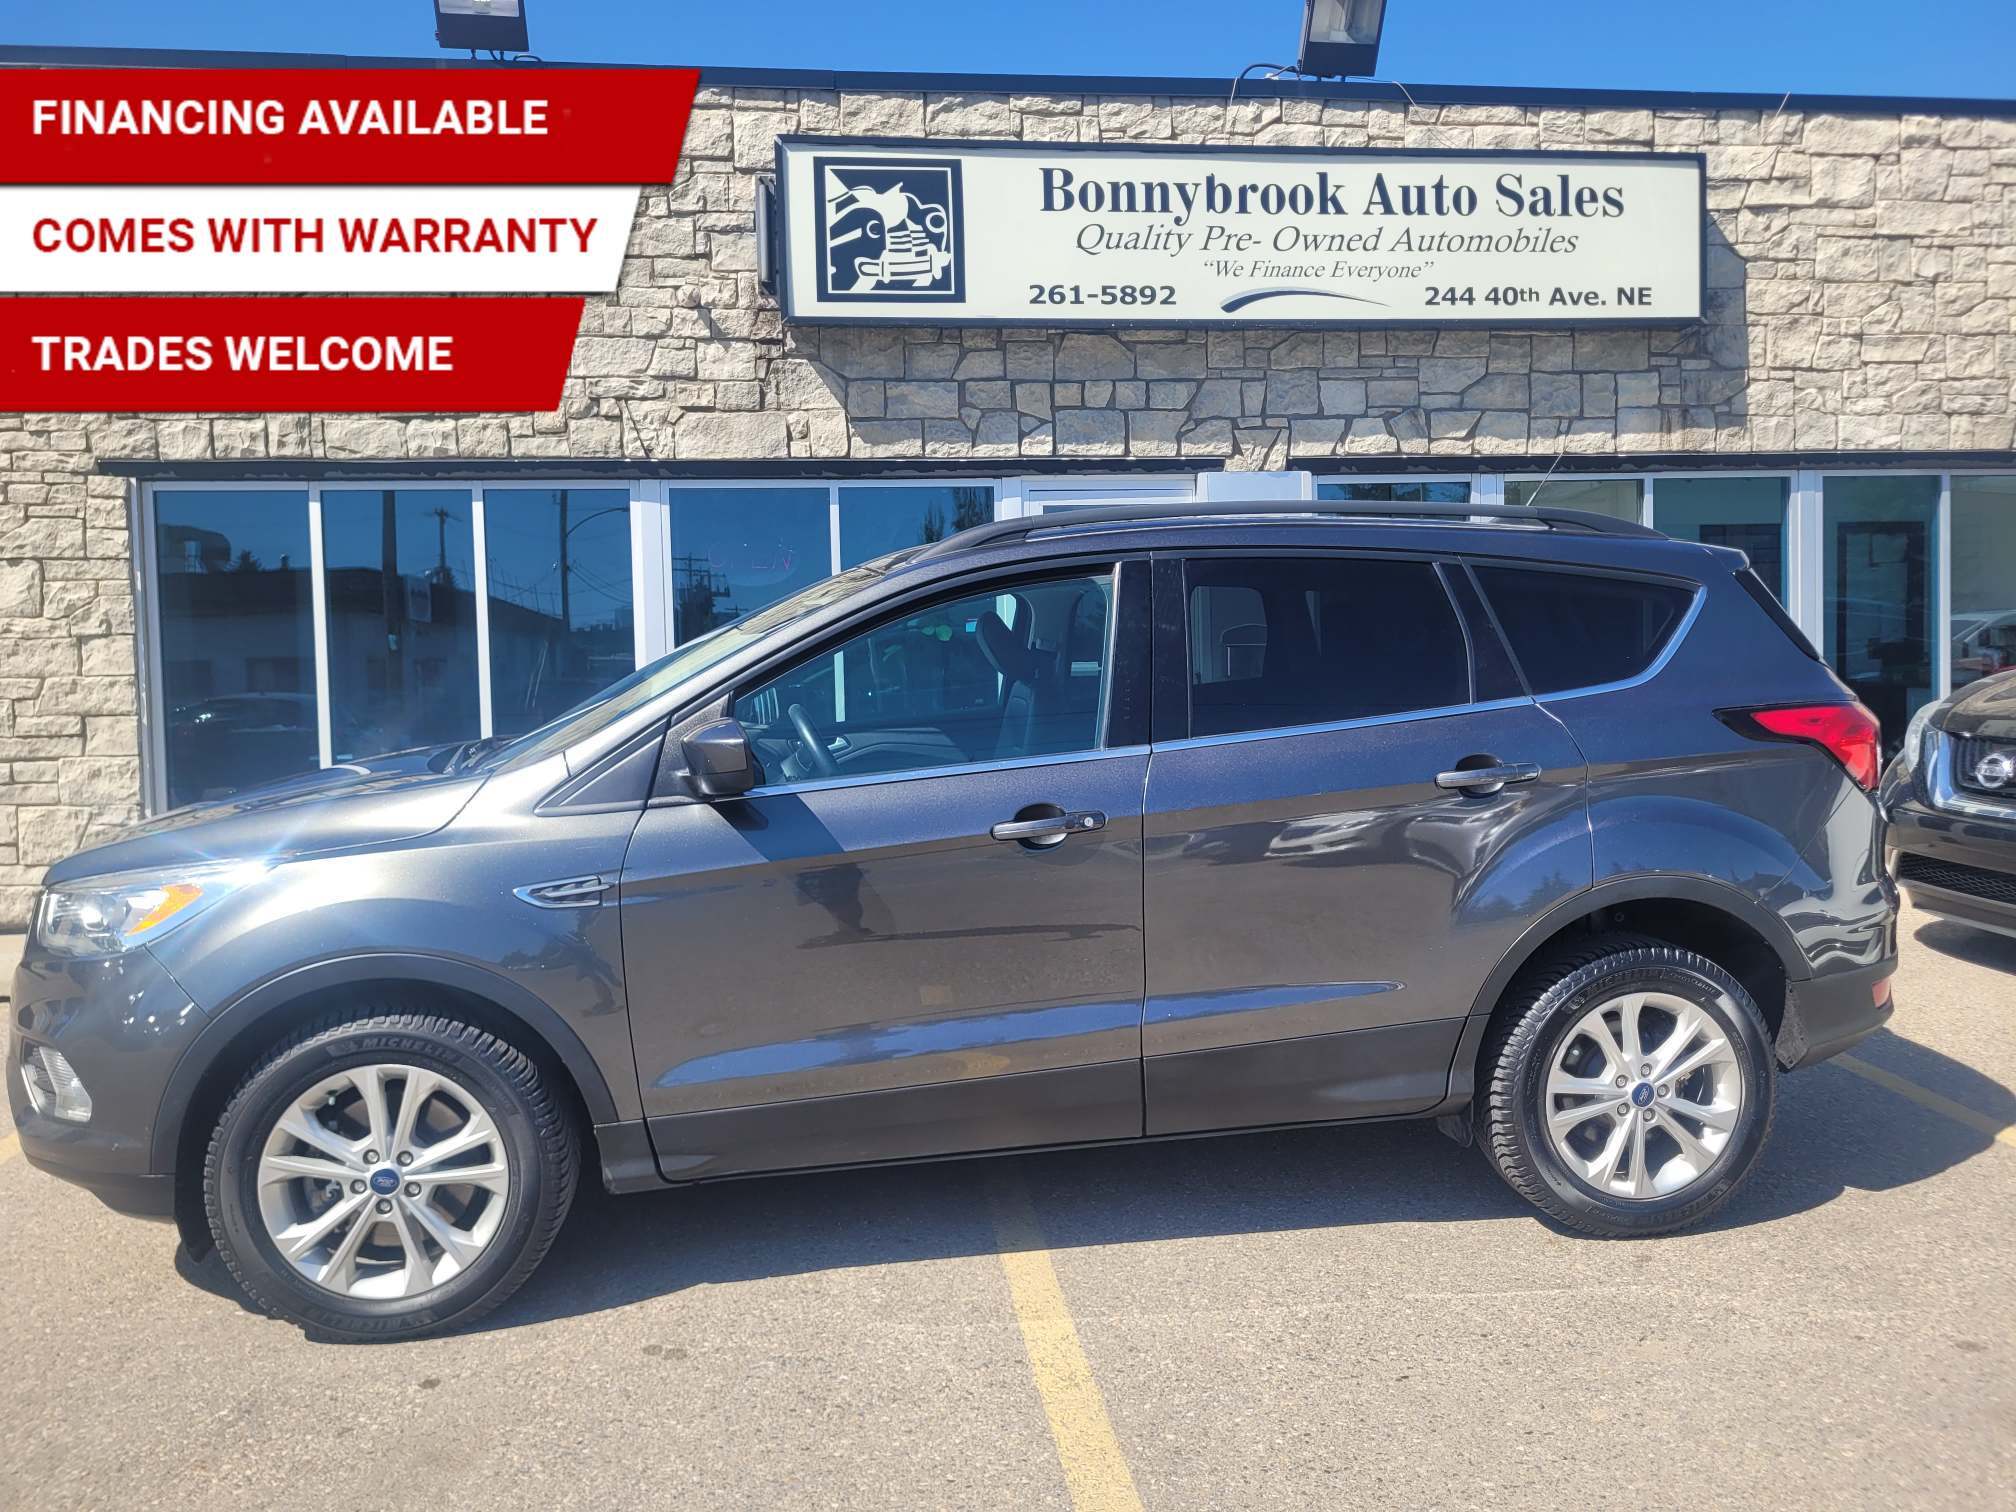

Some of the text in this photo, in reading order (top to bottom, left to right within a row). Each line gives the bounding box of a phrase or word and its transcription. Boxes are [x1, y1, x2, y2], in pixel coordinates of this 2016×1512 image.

[1039, 167, 1625, 226] Bonnybrook Auto Sales
[1076, 223, 1579, 257] Quality Pre- Owned Automobiles
[1248, 260, 1326, 278] Finance
[1028, 284, 1177, 306] 261-5892
[1424, 286, 1653, 306] 244 40th Ave. NE
